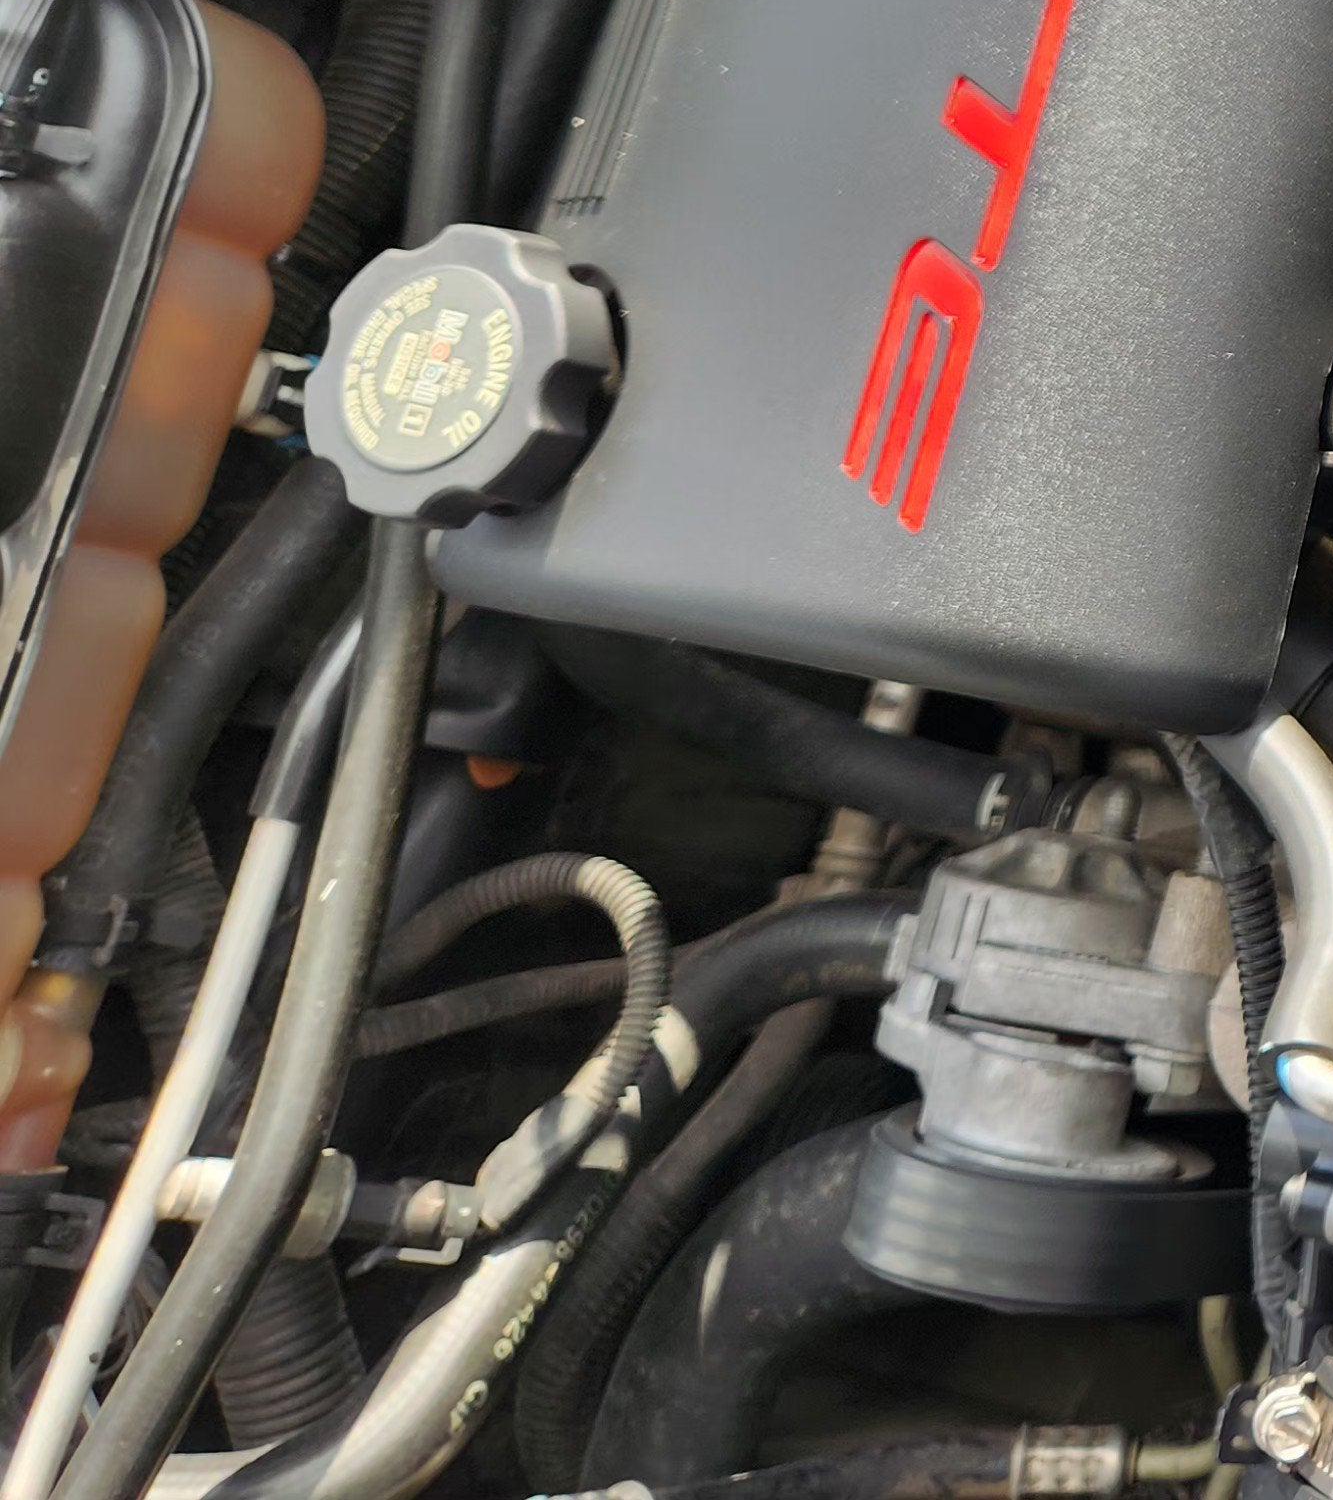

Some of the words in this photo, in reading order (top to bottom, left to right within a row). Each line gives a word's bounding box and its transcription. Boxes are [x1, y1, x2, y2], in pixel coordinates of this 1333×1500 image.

[411, 308, 470, 405] Mobil
[475, 308, 513, 409] ENGINE
[360, 372, 386, 428] MANUAL
[441, 409, 482, 448] OIL
